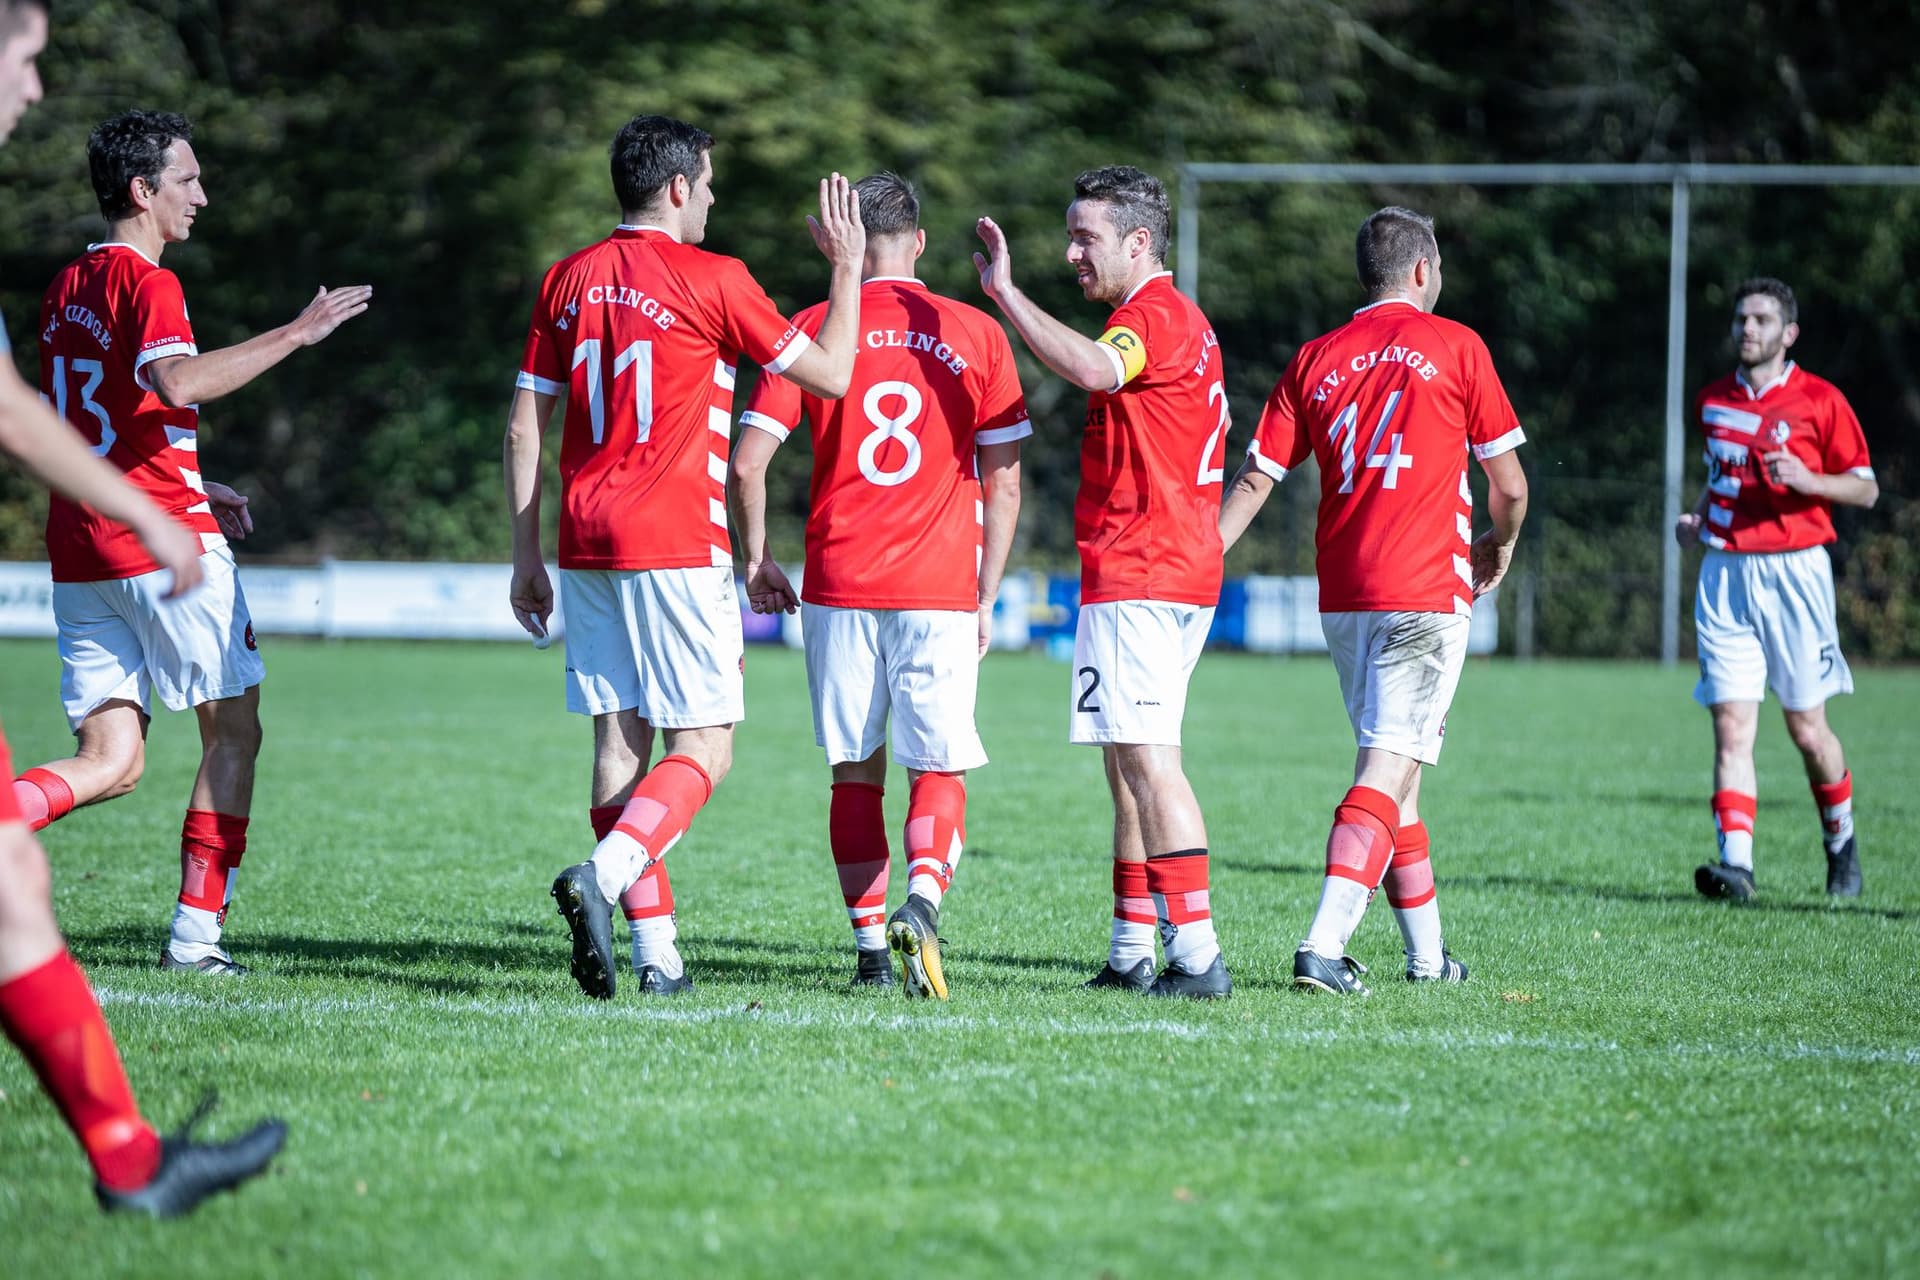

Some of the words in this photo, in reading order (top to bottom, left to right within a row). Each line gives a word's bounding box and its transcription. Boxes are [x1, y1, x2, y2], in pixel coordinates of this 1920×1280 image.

[65, 304, 112, 351] CLINGE
[587, 285, 676, 331] CLINGE
[144, 335, 181, 349] CLINGE
[866, 329, 968, 376] CLINGE
[1109, 332, 1136, 351] C
[571, 338, 653, 444] 11
[1313, 369, 1346, 402] V.V.
[1351, 345, 1439, 381] CLINGE
[53, 355, 118, 457] 13
[857, 380, 923, 487] 8
[1196, 380, 1229, 486] 2
[1327, 390, 1413, 494] 14
[1820, 643, 1836, 681] 5
[1077, 666, 1101, 713] 2
